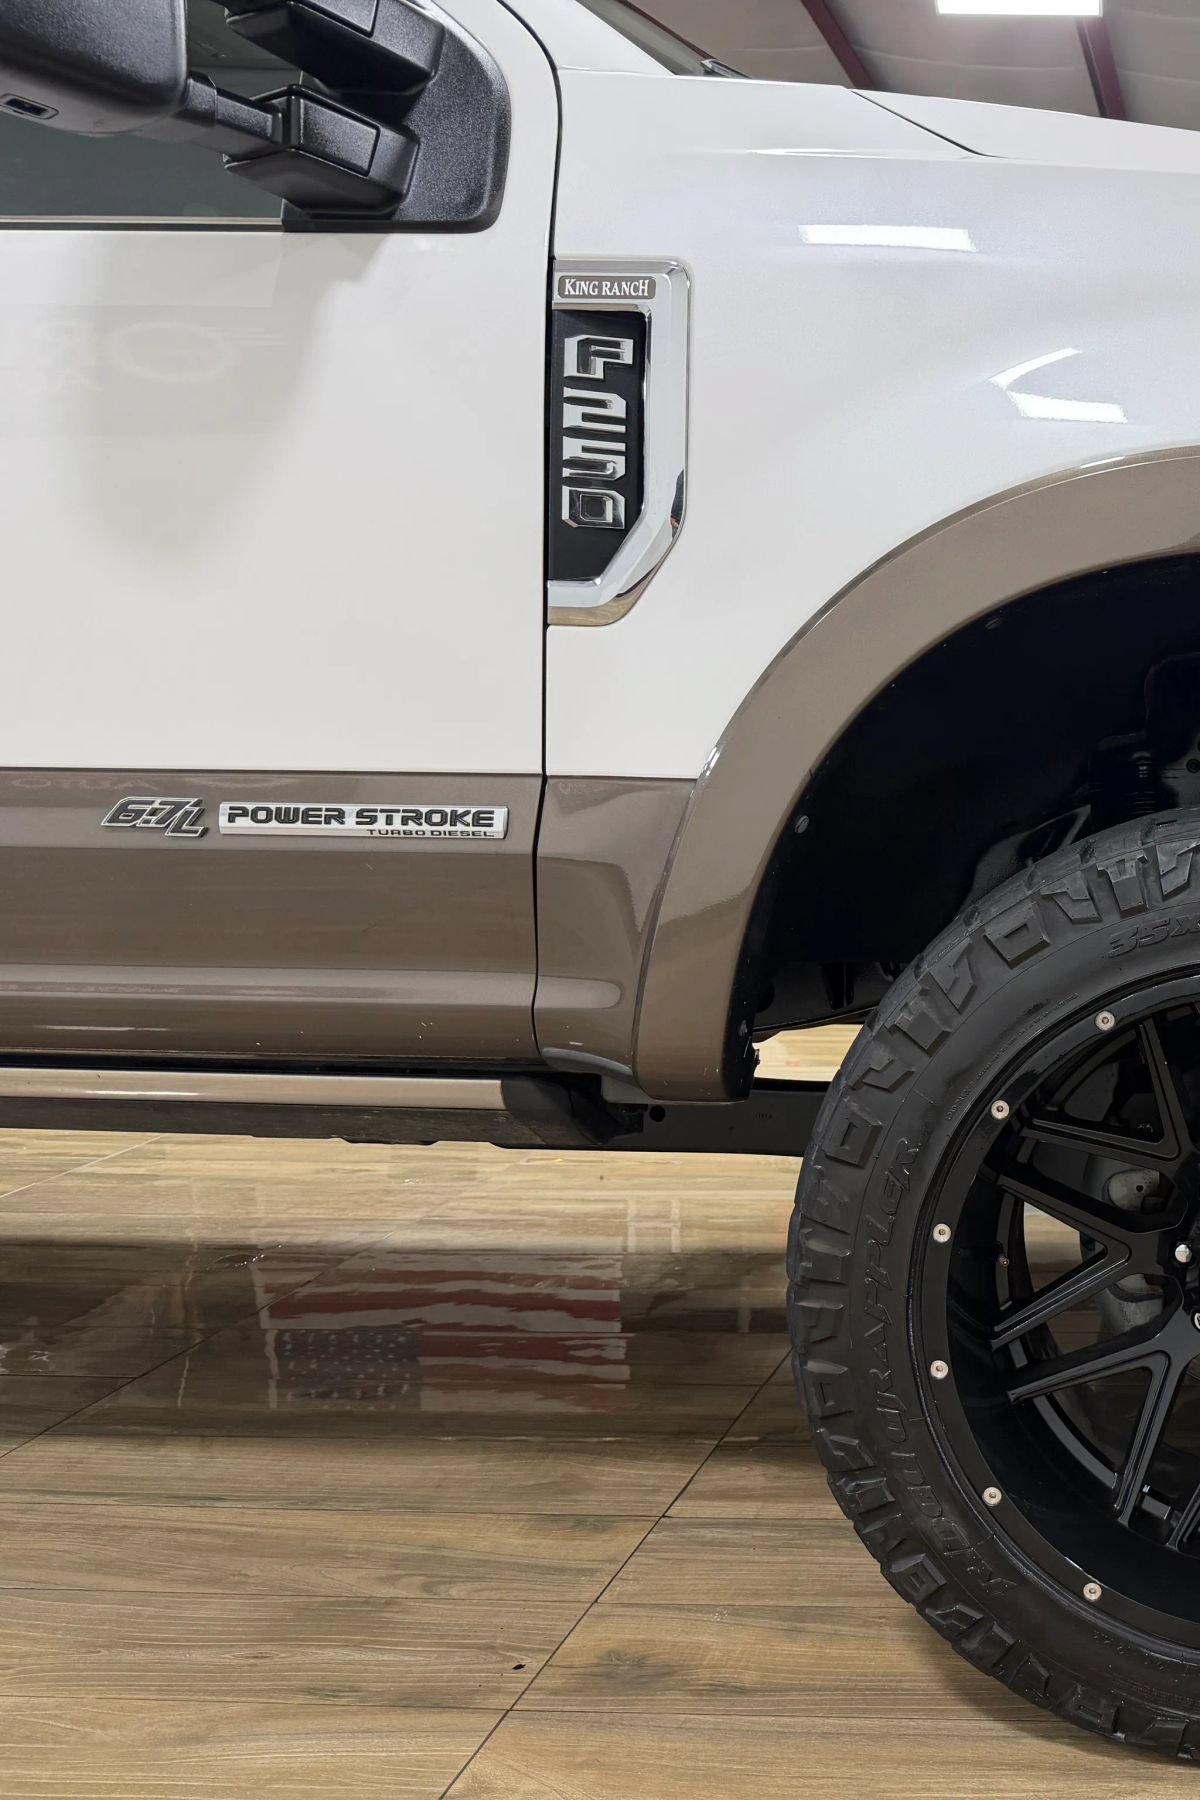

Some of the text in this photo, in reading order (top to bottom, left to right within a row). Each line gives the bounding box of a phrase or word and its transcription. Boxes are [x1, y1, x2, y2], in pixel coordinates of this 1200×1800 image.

[563, 278, 649, 297] KING RANCH
[562, 334, 634, 529] F250
[227, 805, 495, 828] POWER STROKE
[366, 828, 495, 838] TURBO DIESEL
